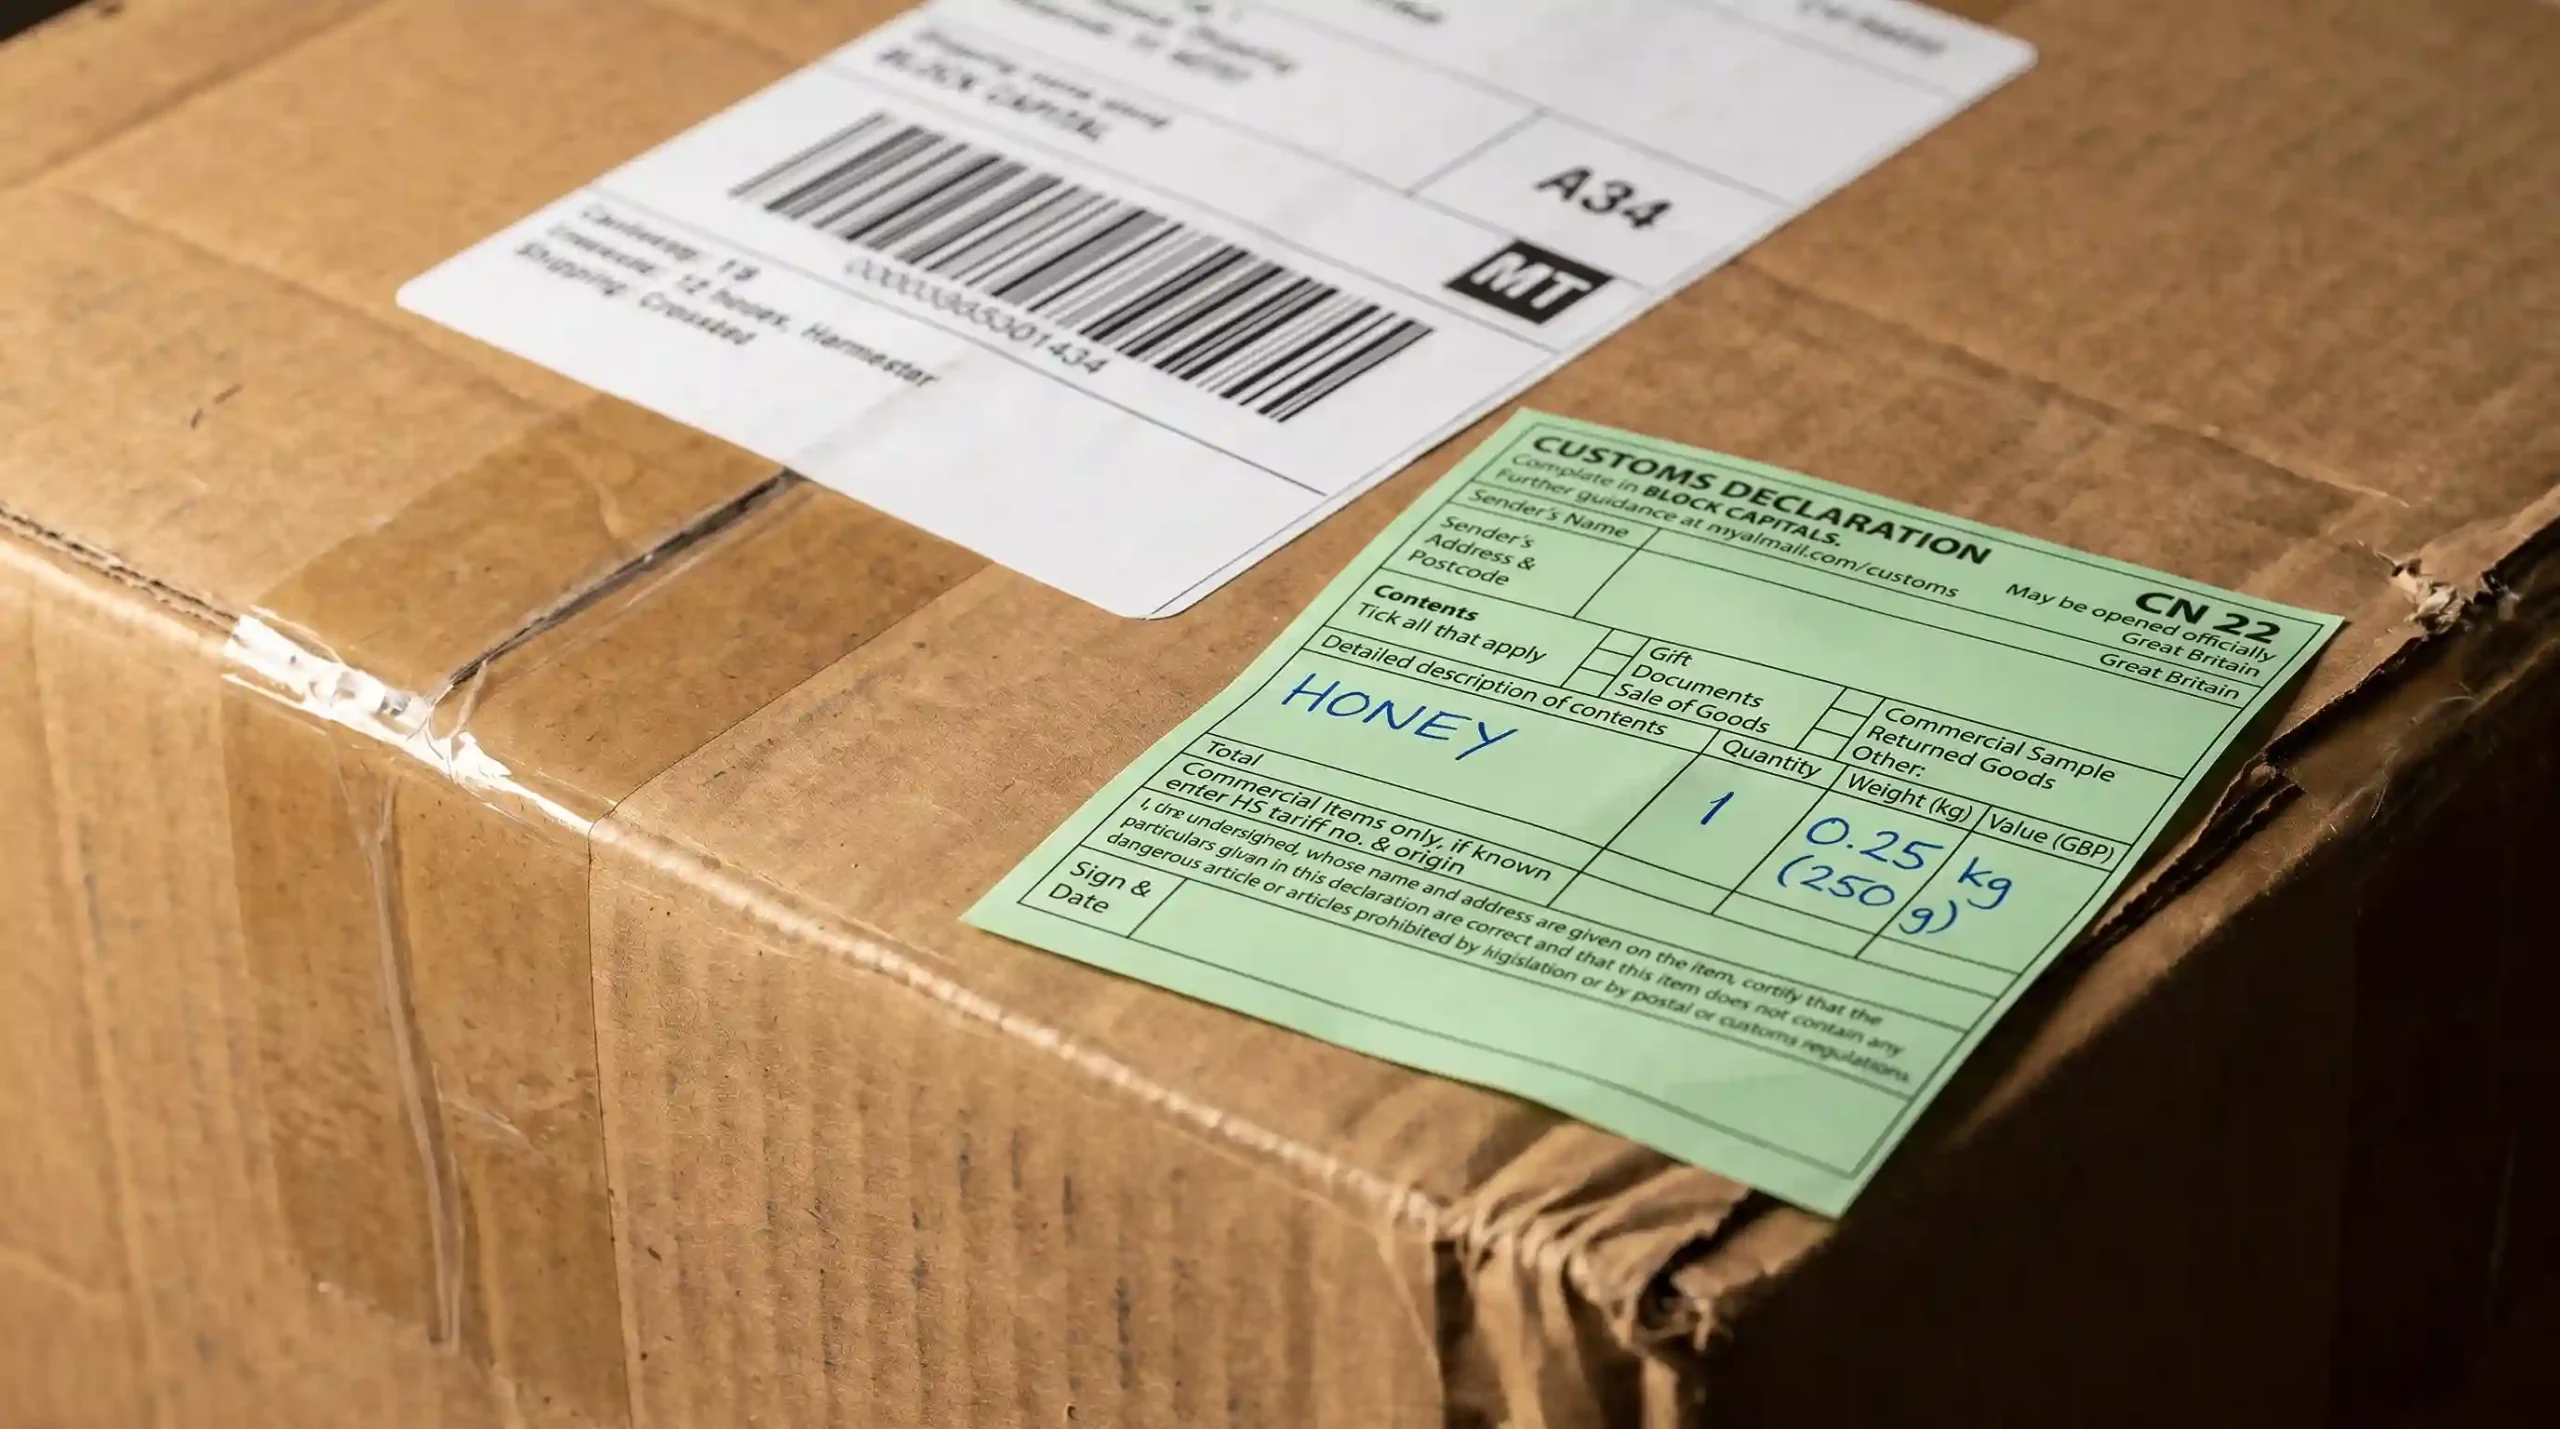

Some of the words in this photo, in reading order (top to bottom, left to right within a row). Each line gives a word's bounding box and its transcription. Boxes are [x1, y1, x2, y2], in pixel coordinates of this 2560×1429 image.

[1533, 166, 1674, 230] A34
[1469, 250, 1593, 310] MT
[1468, 489, 1561, 522] Sender's
[1563, 512, 1630, 538] Name
[1495, 467, 1575, 495] Further
[1574, 490, 1679, 522] guidance
[1679, 516, 1705, 529] at
[1532, 436, 1718, 490] CUSTOMS
[1719, 480, 1993, 565] DECLARATION
[1616, 479, 1639, 494] in
[1642, 485, 1724, 515] BLOCK
[1724, 506, 1841, 547] CAPITALS.
[1424, 533, 1515, 565] Address
[1516, 556, 1536, 571] &
[1440, 515, 1534, 549] Sender's
[1407, 549, 1510, 586] Postcode
[1373, 584, 1480, 622] Contents
[2005, 583, 2056, 606] May
[2058, 595, 2088, 613] be
[2091, 608, 2182, 636] opened
[2181, 631, 2277, 663] officially
[2135, 592, 2210, 625] CN
[2212, 612, 2281, 645] 22
[1357, 601, 1402, 626] Tick
[1401, 617, 1434, 633] all
[1433, 624, 1482, 647] that
[1481, 639, 1548, 665] apply
[1649, 646, 1693, 667] Gift
[2121, 632, 2185, 657] Great
[2186, 648, 2261, 678] Britain
[1320, 634, 1417, 670] Detailed
[1415, 660, 1538, 703] description
[1542, 695, 1574, 710] of
[1569, 703, 1669, 736] contents
[1630, 663, 1764, 708] Documents
[2099, 653, 2164, 679] Great
[2164, 670, 2240, 700] Britain
[1281, 672, 1519, 761] HONEY
[1614, 683, 1664, 706] Sale
[1666, 698, 1699, 713] of
[1695, 703, 1771, 734] Goods
[1206, 740, 1265, 767] Total
[1722, 739, 1823, 780] Quantity
[1866, 725, 1979, 767] Returned
[1979, 757, 2057, 790] Goods
[1884, 707, 2027, 757] Commercial
[2026, 746, 2116, 783] Sample
[1182, 762, 1323, 810] Commercial
[1320, 800, 1387, 830] Items
[1381, 824, 1444, 853] only,
[1449, 838, 1474, 854] if
[1470, 844, 1552, 882] known
[1700, 791, 1735, 826] 1
[1848, 772, 1928, 809] Weight
[1928, 796, 1973, 823] (kg)
[1165, 779, 1230, 803] enter
[1229, 793, 1269, 814] HS
[1268, 806, 1333, 833] tariff
[1327, 826, 1363, 846] no.
[1370, 836, 1391, 853] &
[1383, 846, 1465, 882] origin
[1989, 813, 2049, 844] Value
[2052, 832, 2115, 865] (GBP)
[1069, 861, 1127, 890] Sign
[1130, 880, 1151, 898] &
[1805, 817, 1945, 870] 0.25
[1956, 856, 2013, 910] kg
[1048, 882, 1110, 914] Date
[1776, 854, 1896, 907] (250
[1898, 899, 1958, 936] g)
[1106, 832, 1203, 869] dangerous
[1202, 863, 1261, 888] article
[1262, 882, 1286, 894] or
[1285, 888, 1354, 916] articles
[1351, 909, 1456, 946] prohibited
[1454, 935, 1481, 956] by
[1580, 976, 1604, 988] or
[1604, 979, 1631, 998] by
[1630, 990, 1695, 1014] postal
[1693, 1009, 1717, 1022] or
[1119, 816, 1217, 851] particulars
[1269, 858, 1289, 873] in
[1292, 865, 1328, 885] this
[1327, 877, 1430, 916] declaration
[1432, 909, 1464, 926] are
[1466, 920, 1534, 947] correct
[1533, 940, 1575, 958] and
[1575, 950, 1616, 971] that
[1618, 962, 1654, 982] this
[1655, 974, 1701, 996] item
[1704, 988, 1751, 1011] does
[1753, 1004, 1791, 1021] not
[1866, 1037, 1905, 1059] any
[1306, 848, 1366, 874] whose
[1367, 867, 1420, 890] name
[1421, 883, 1462, 902] and
[1460, 895, 1534, 924] address
[1535, 918, 1567, 934] are
[1566, 928, 1623, 951] given
[1625, 945, 1652, 960] on
[1655, 951, 1689, 970] the
[1689, 961, 1736, 986] item,
[1804, 994, 1847, 1016] that
[1849, 1007, 1884, 1026] the
